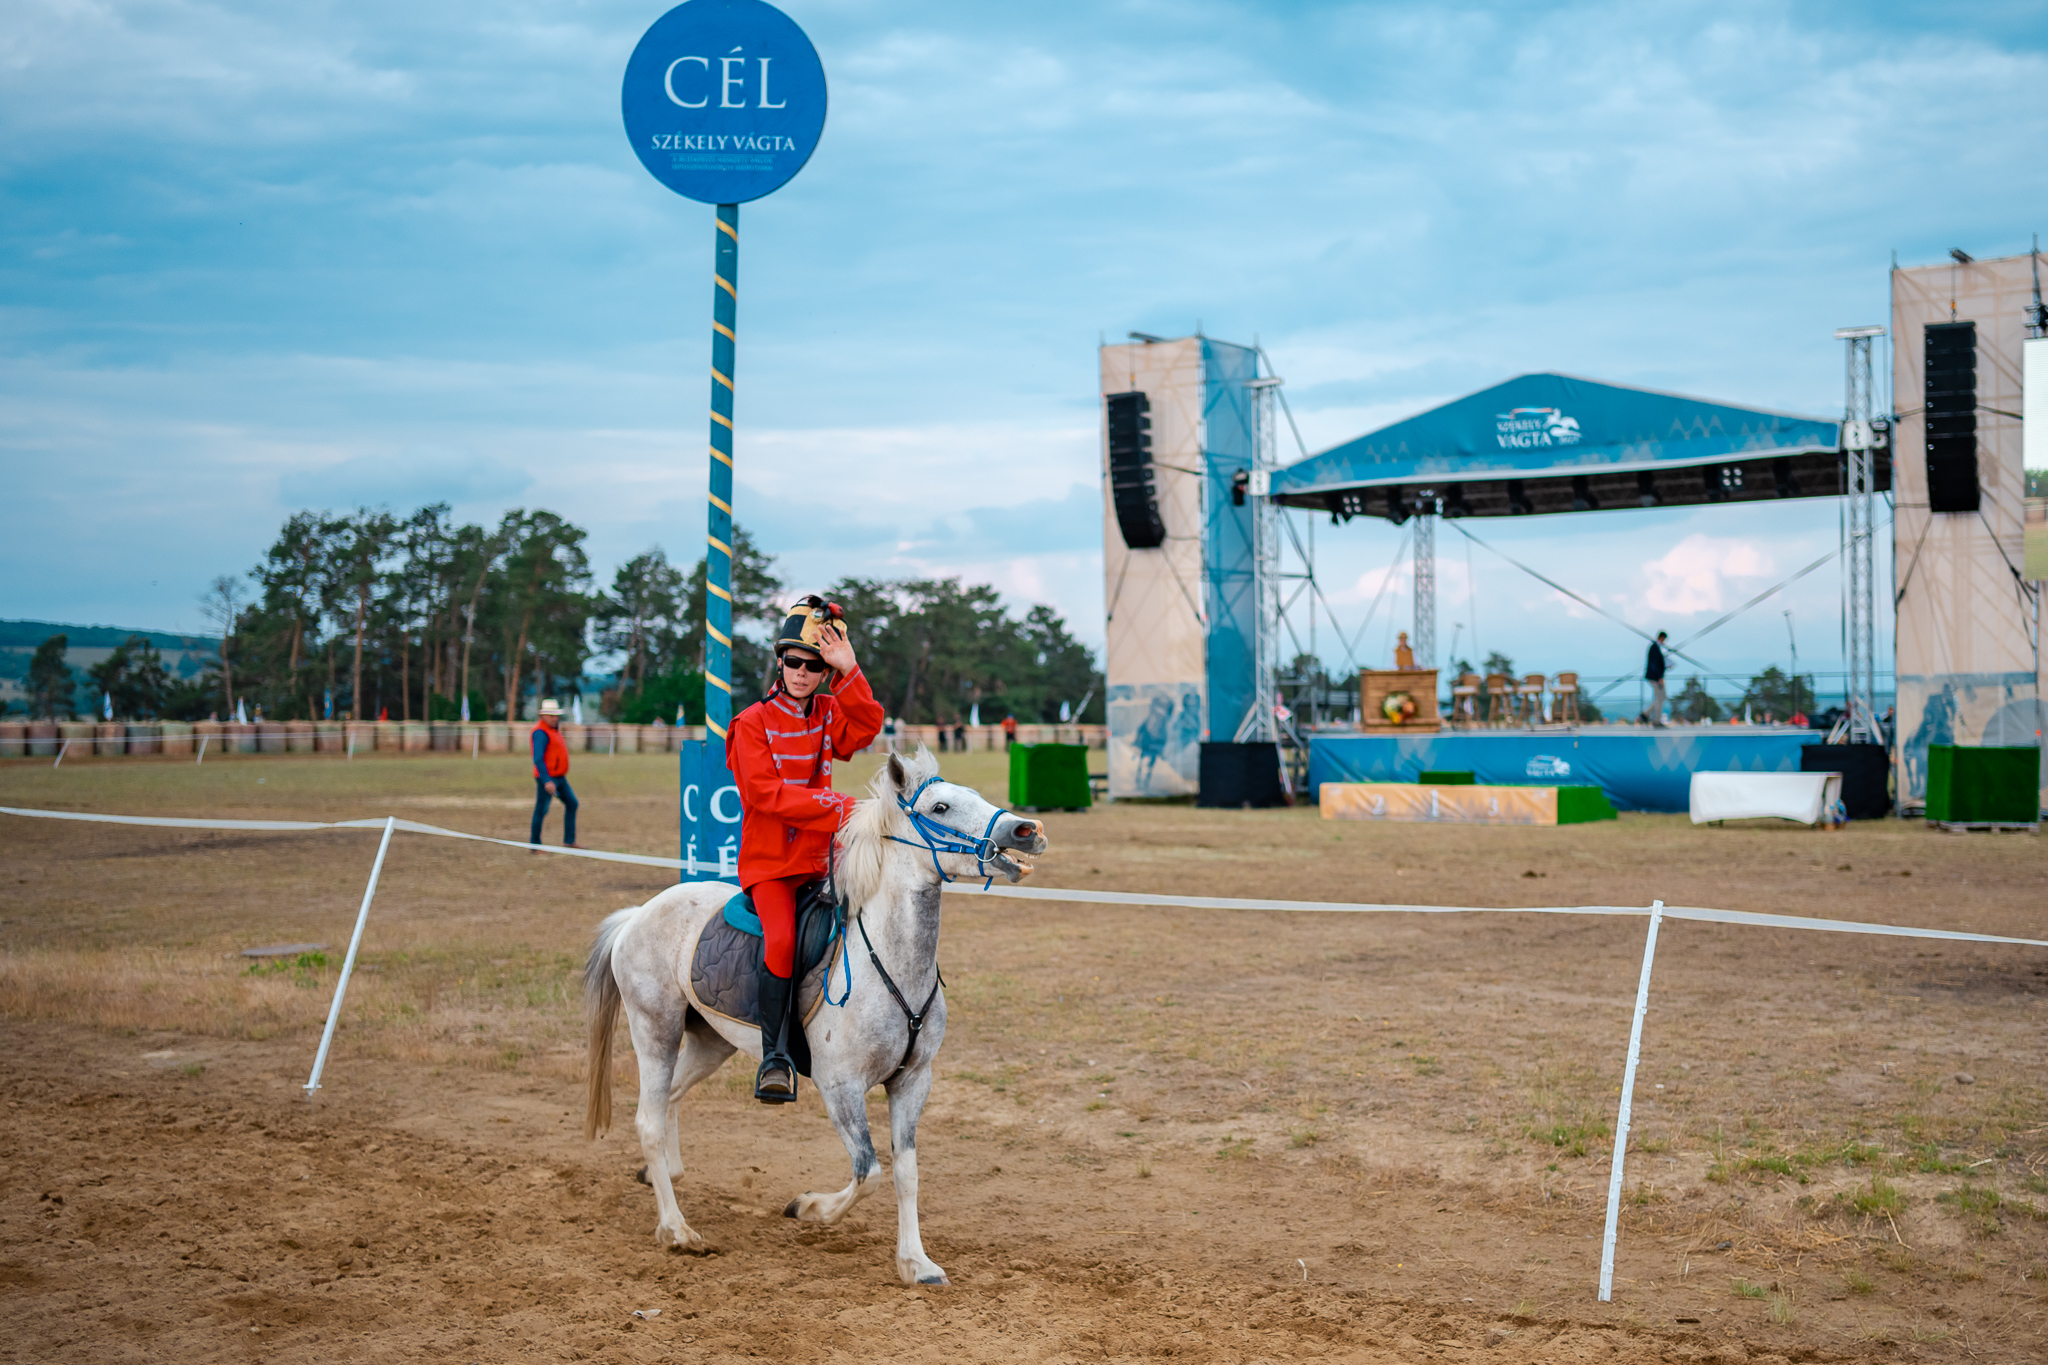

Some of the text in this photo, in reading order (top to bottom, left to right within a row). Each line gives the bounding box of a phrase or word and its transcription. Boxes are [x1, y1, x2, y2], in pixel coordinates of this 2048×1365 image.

[663, 45, 787, 109] CÉL
[650, 130, 796, 151] SZÉKELY VÁGTA
